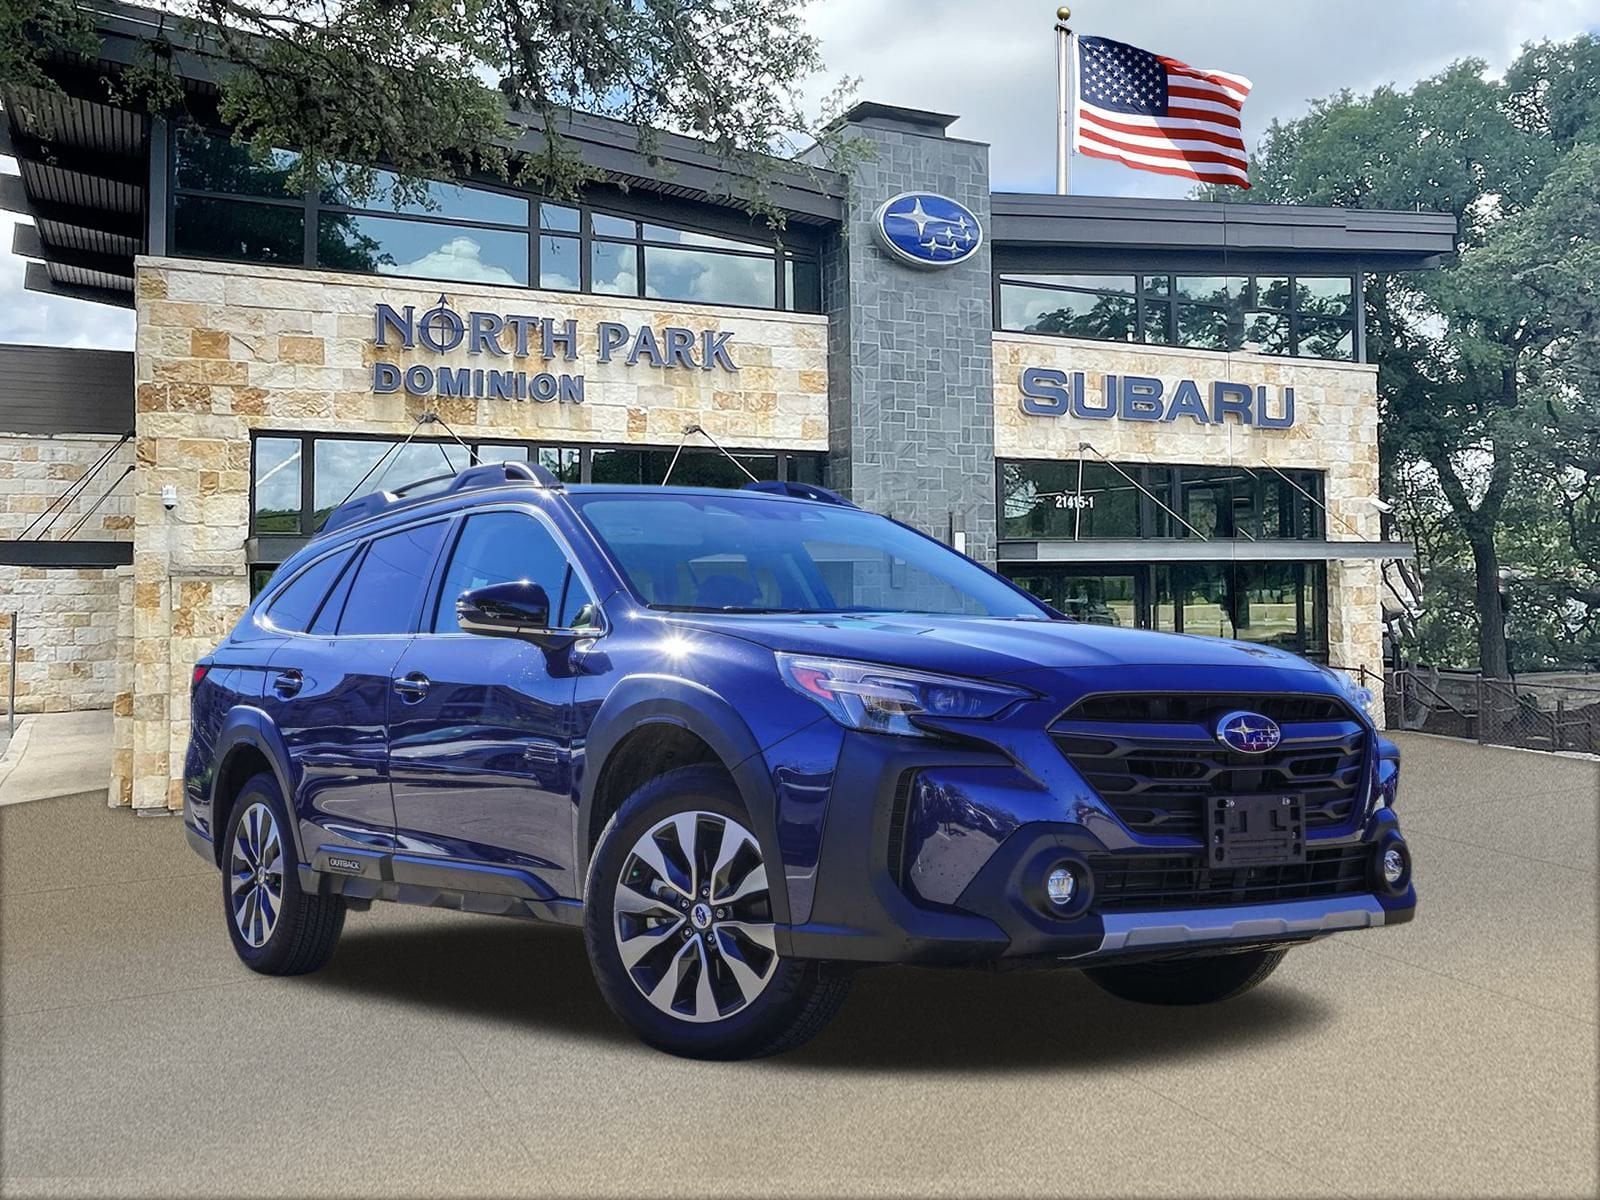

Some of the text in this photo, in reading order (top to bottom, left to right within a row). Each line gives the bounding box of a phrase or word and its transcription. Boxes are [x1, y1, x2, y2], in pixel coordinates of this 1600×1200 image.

[375, 294, 740, 373] NORTH PARK
[373, 361, 585, 405] DOMINION
[1018, 366, 1295, 431] SUBARU
[1055, 494, 1094, 510] 21415-1
[329, 858, 360, 870] OUTBACK
